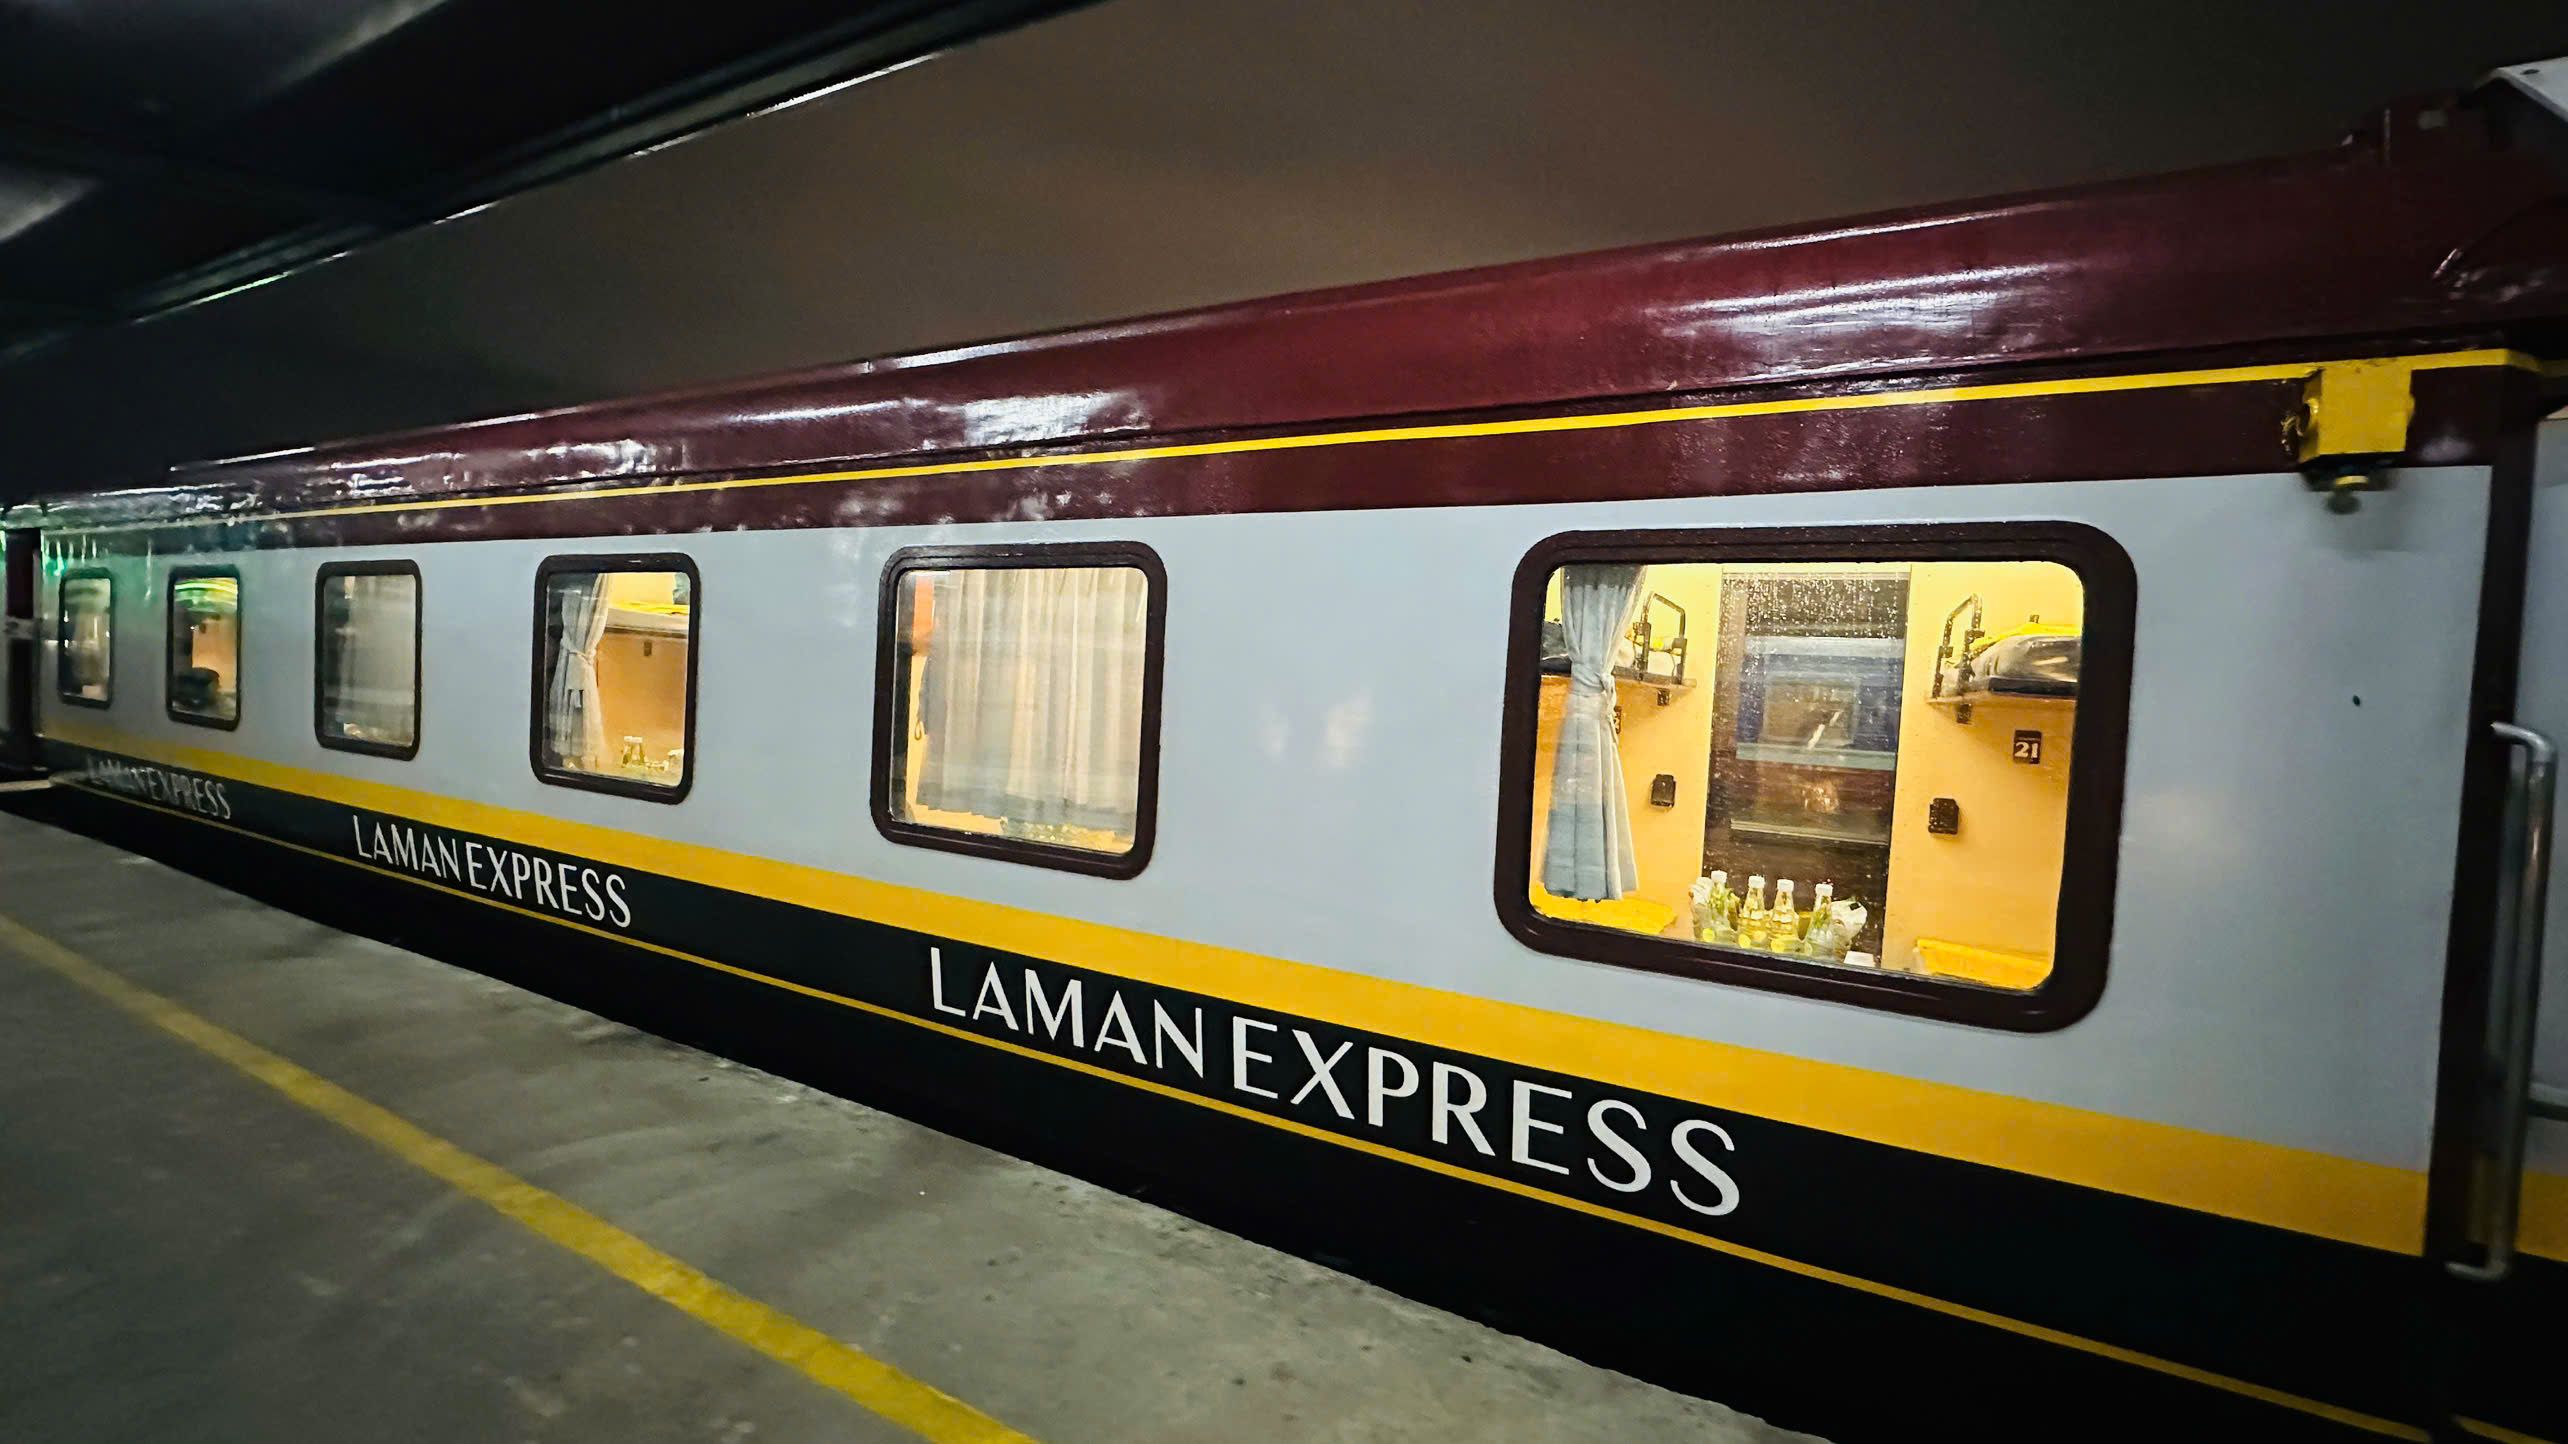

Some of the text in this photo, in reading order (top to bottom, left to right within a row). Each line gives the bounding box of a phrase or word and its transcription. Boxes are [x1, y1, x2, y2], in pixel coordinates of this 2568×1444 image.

[2014, 741, 2039, 759] 21
[147, 767, 231, 820] EXPRESS
[353, 815, 632, 928] LAMAN EXPRESS
[930, 946, 1741, 1217] LAMAN EXPRESS
